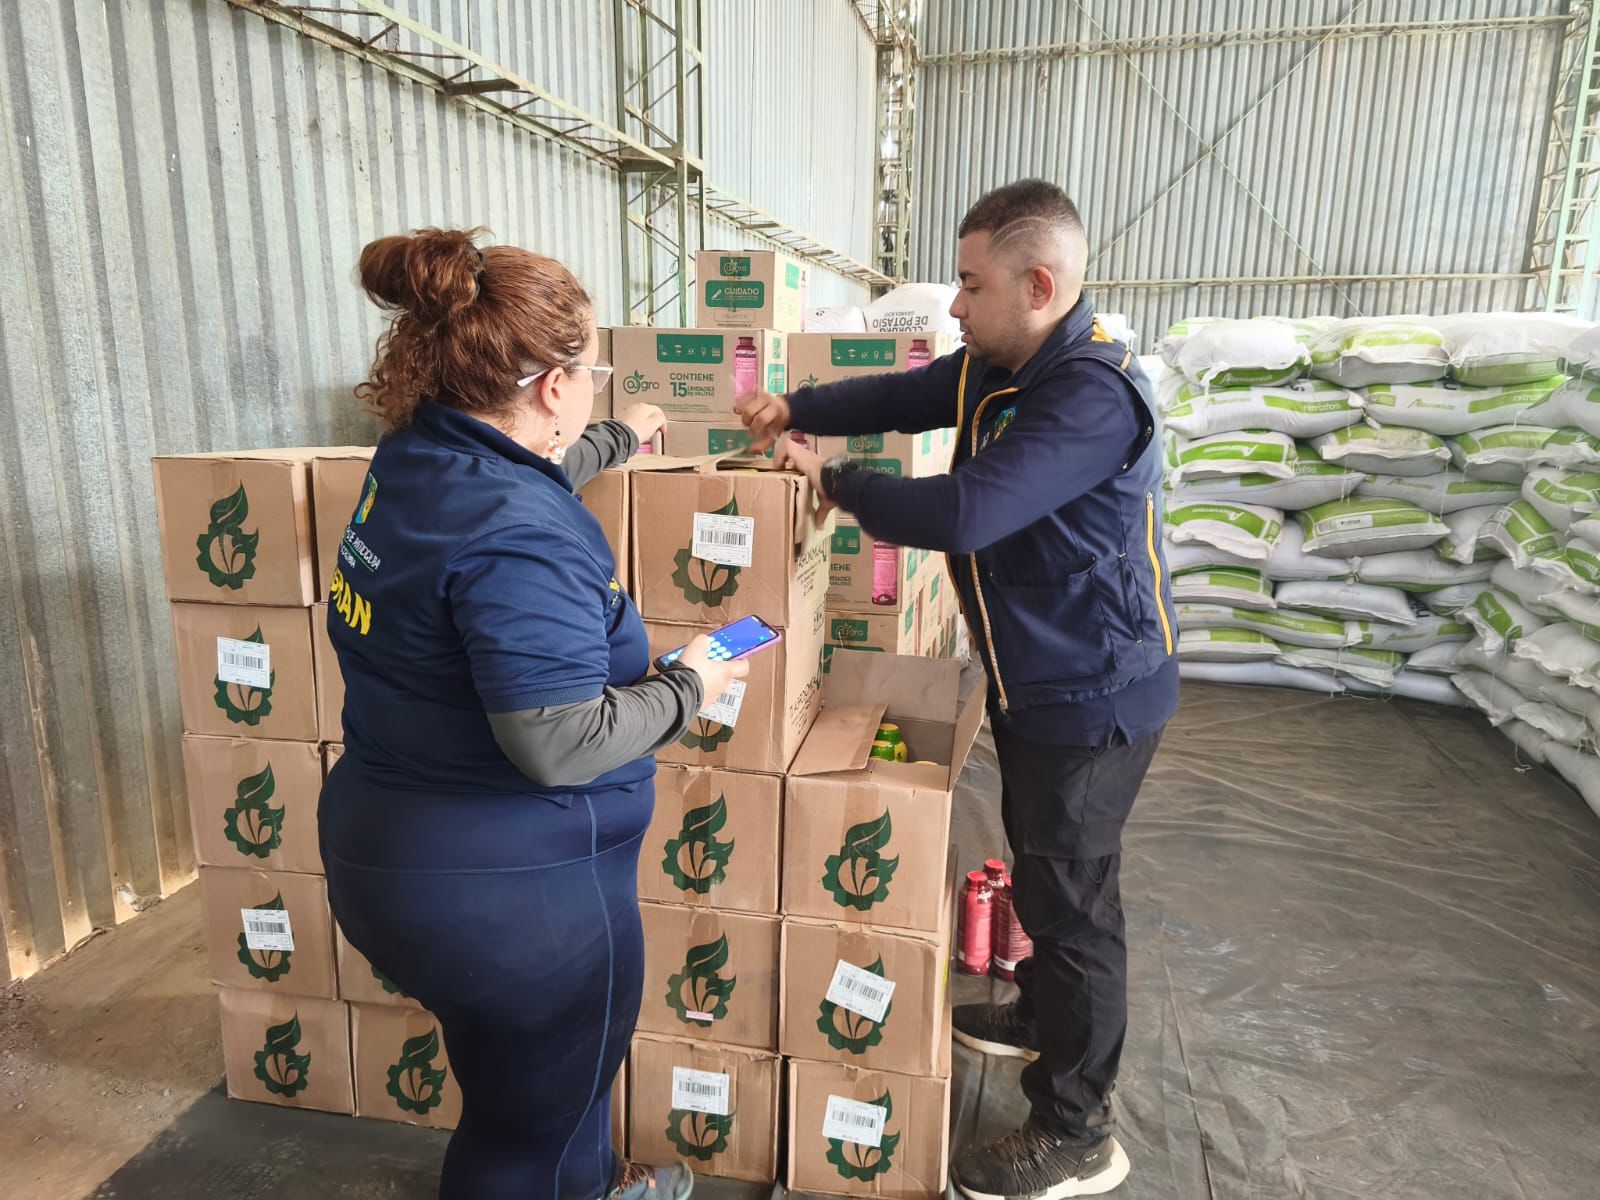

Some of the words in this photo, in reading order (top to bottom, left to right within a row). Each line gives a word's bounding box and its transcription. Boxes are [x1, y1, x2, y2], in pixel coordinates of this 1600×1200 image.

[724, 287, 760, 296] CUIDADO
[872, 317, 913, 329] POTASIO
[914, 315, 929, 326] DE
[669, 372, 715, 382] CONTIENE
[670, 382, 687, 398] 15
